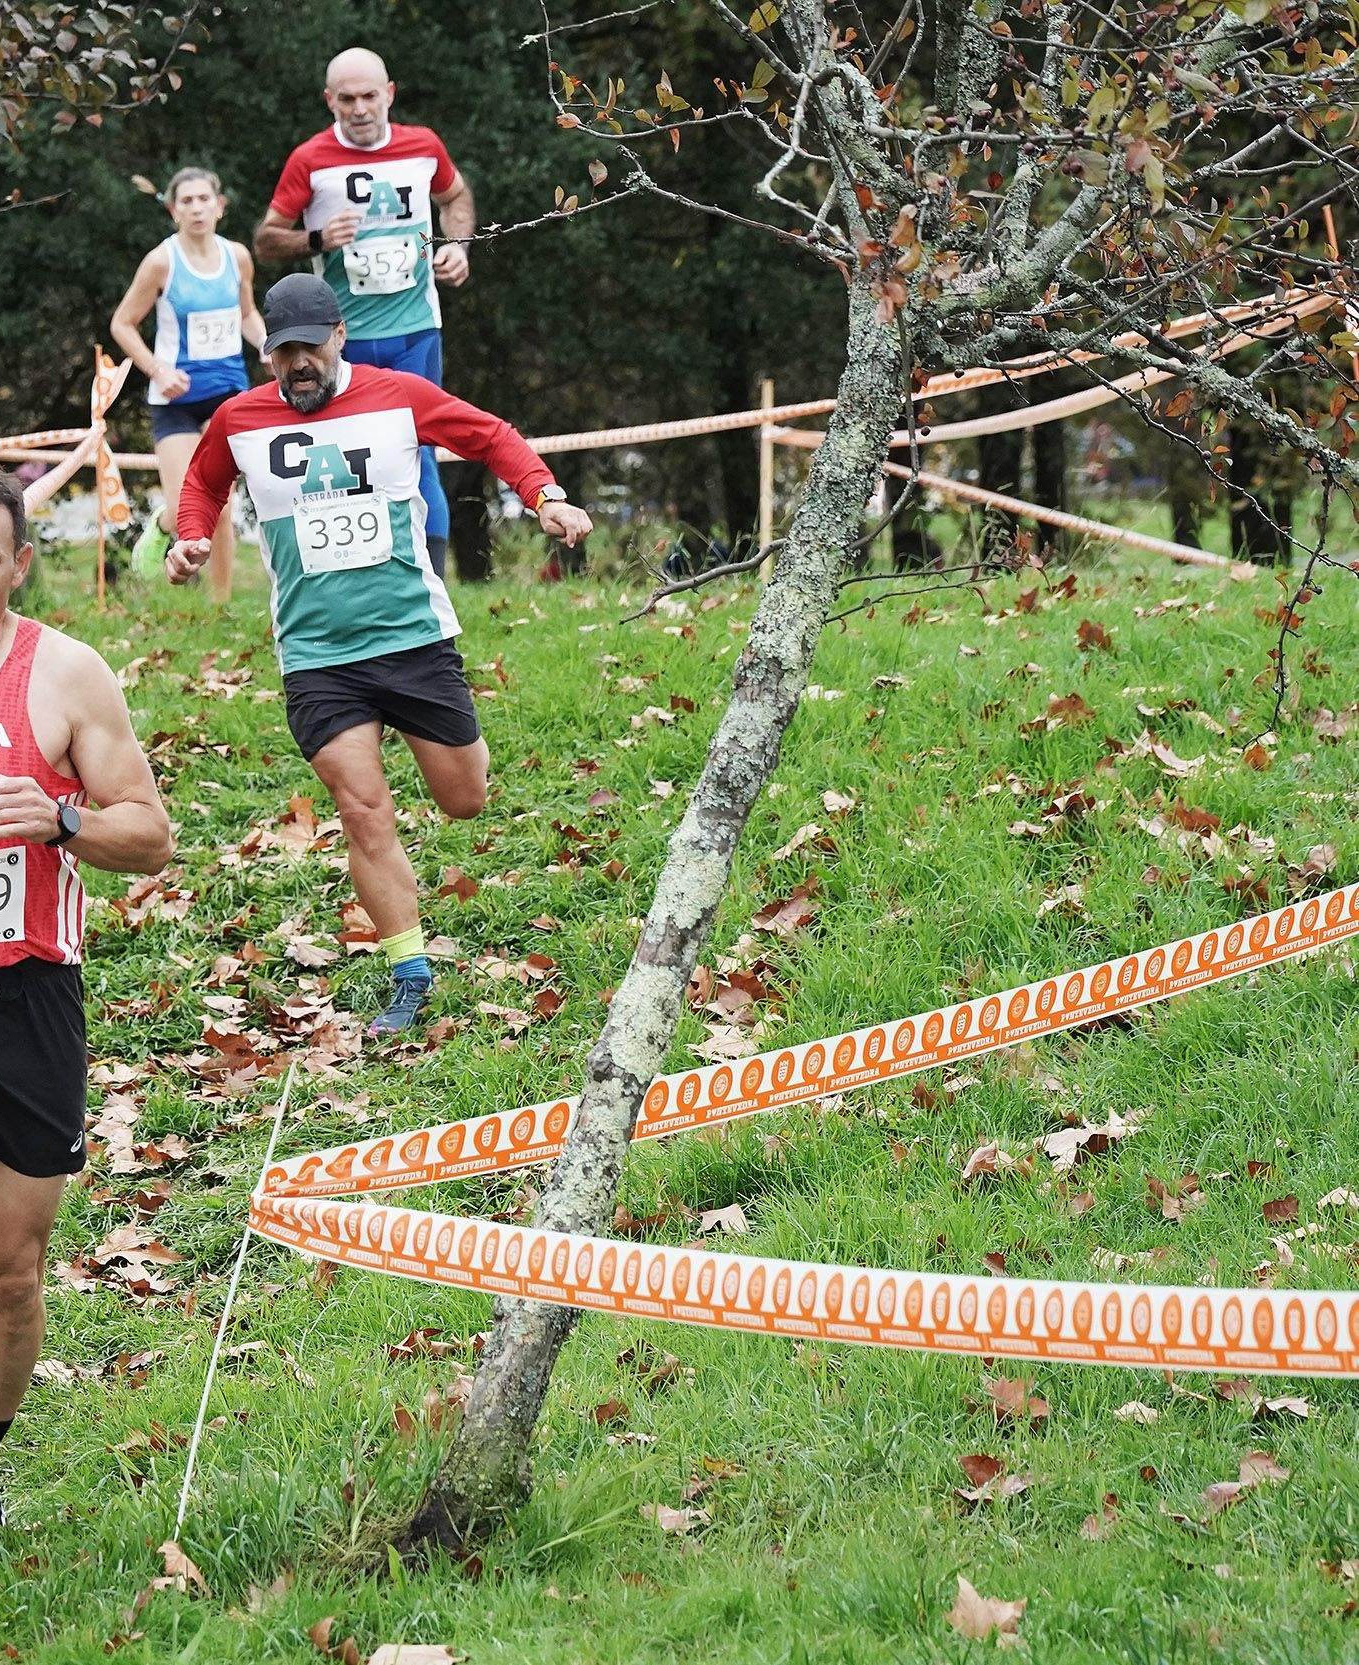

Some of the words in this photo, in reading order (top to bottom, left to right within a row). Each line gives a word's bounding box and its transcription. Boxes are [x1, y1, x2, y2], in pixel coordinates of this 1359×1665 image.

[356, 249, 409, 278] 352
[269, 431, 374, 497] CAI
[308, 511, 379, 550] 339
